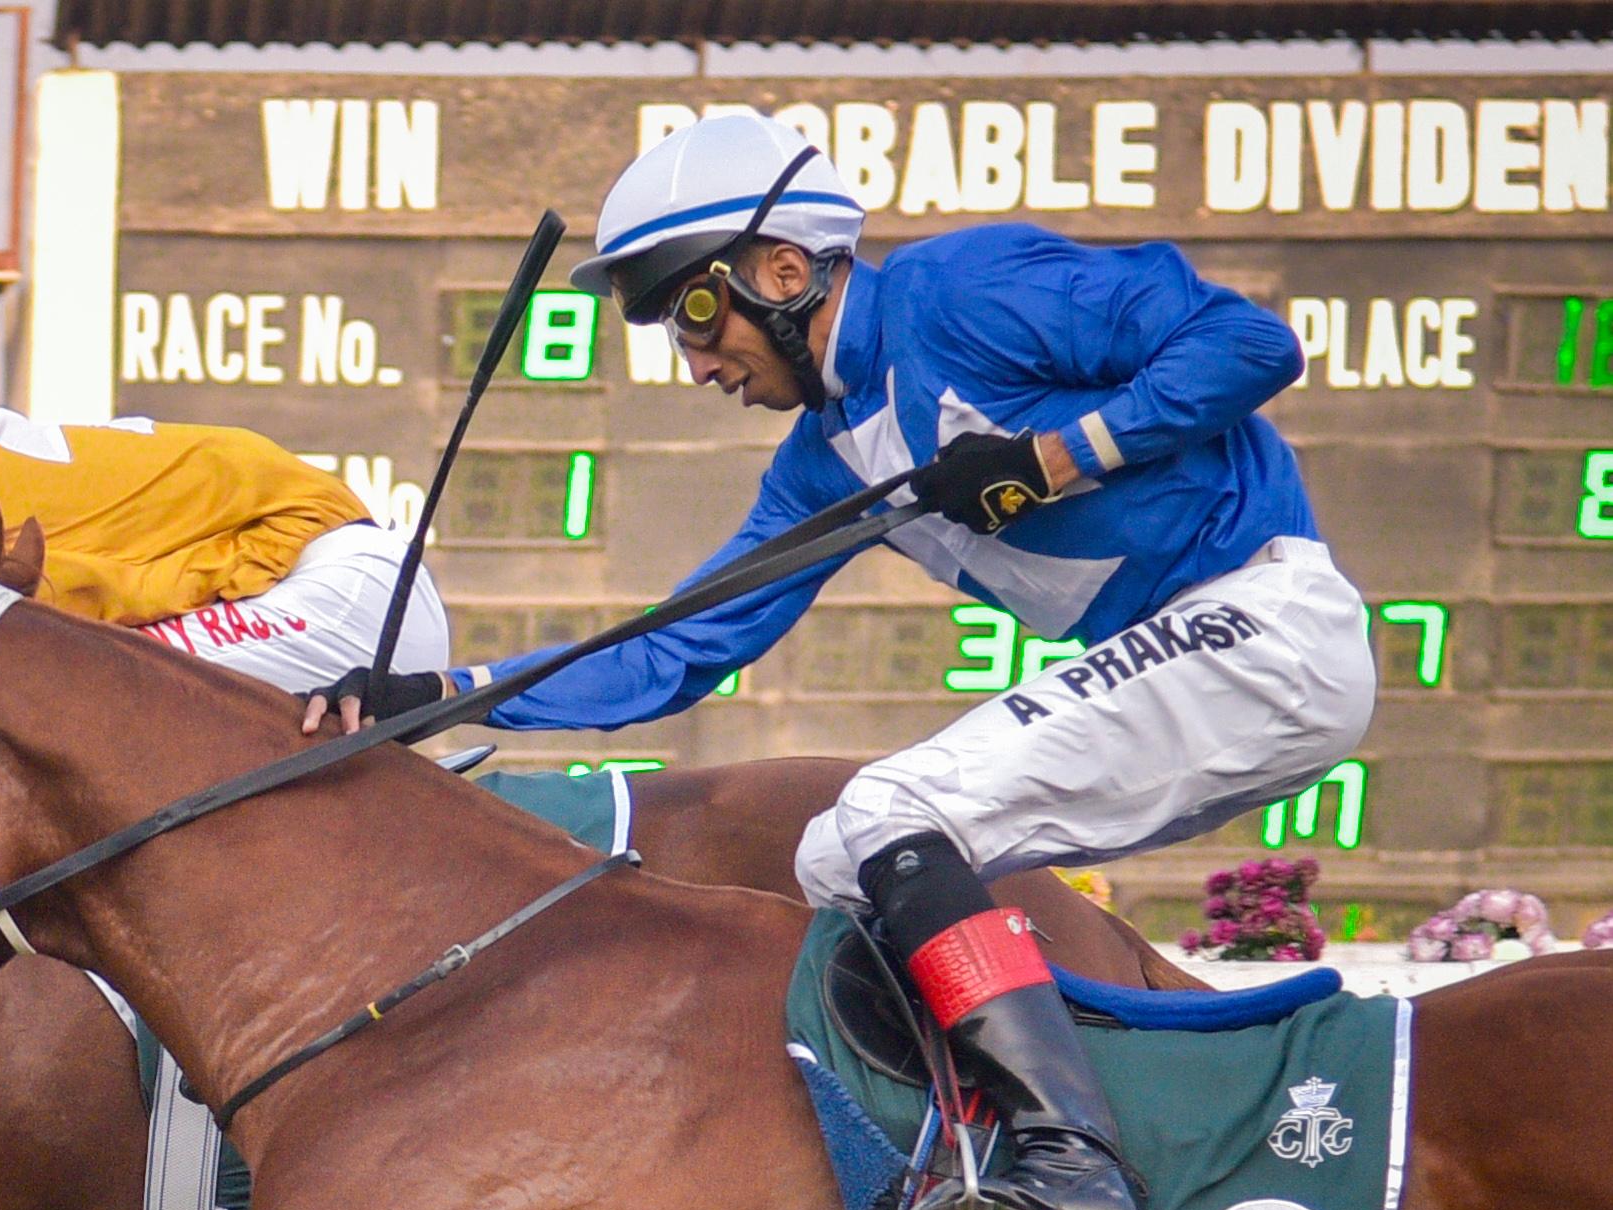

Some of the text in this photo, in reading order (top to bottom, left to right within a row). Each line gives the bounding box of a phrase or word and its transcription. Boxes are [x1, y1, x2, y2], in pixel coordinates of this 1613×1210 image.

[262, 100, 439, 209] WIN
[638, 101, 1157, 213] BABLE
[121, 293, 403, 384] RACE No.
[522, 290, 599, 381] 8
[1290, 298, 1477, 389] PLACE
[564, 451, 595, 540] 1
[1002, 605, 1263, 727] A PRAKASH
